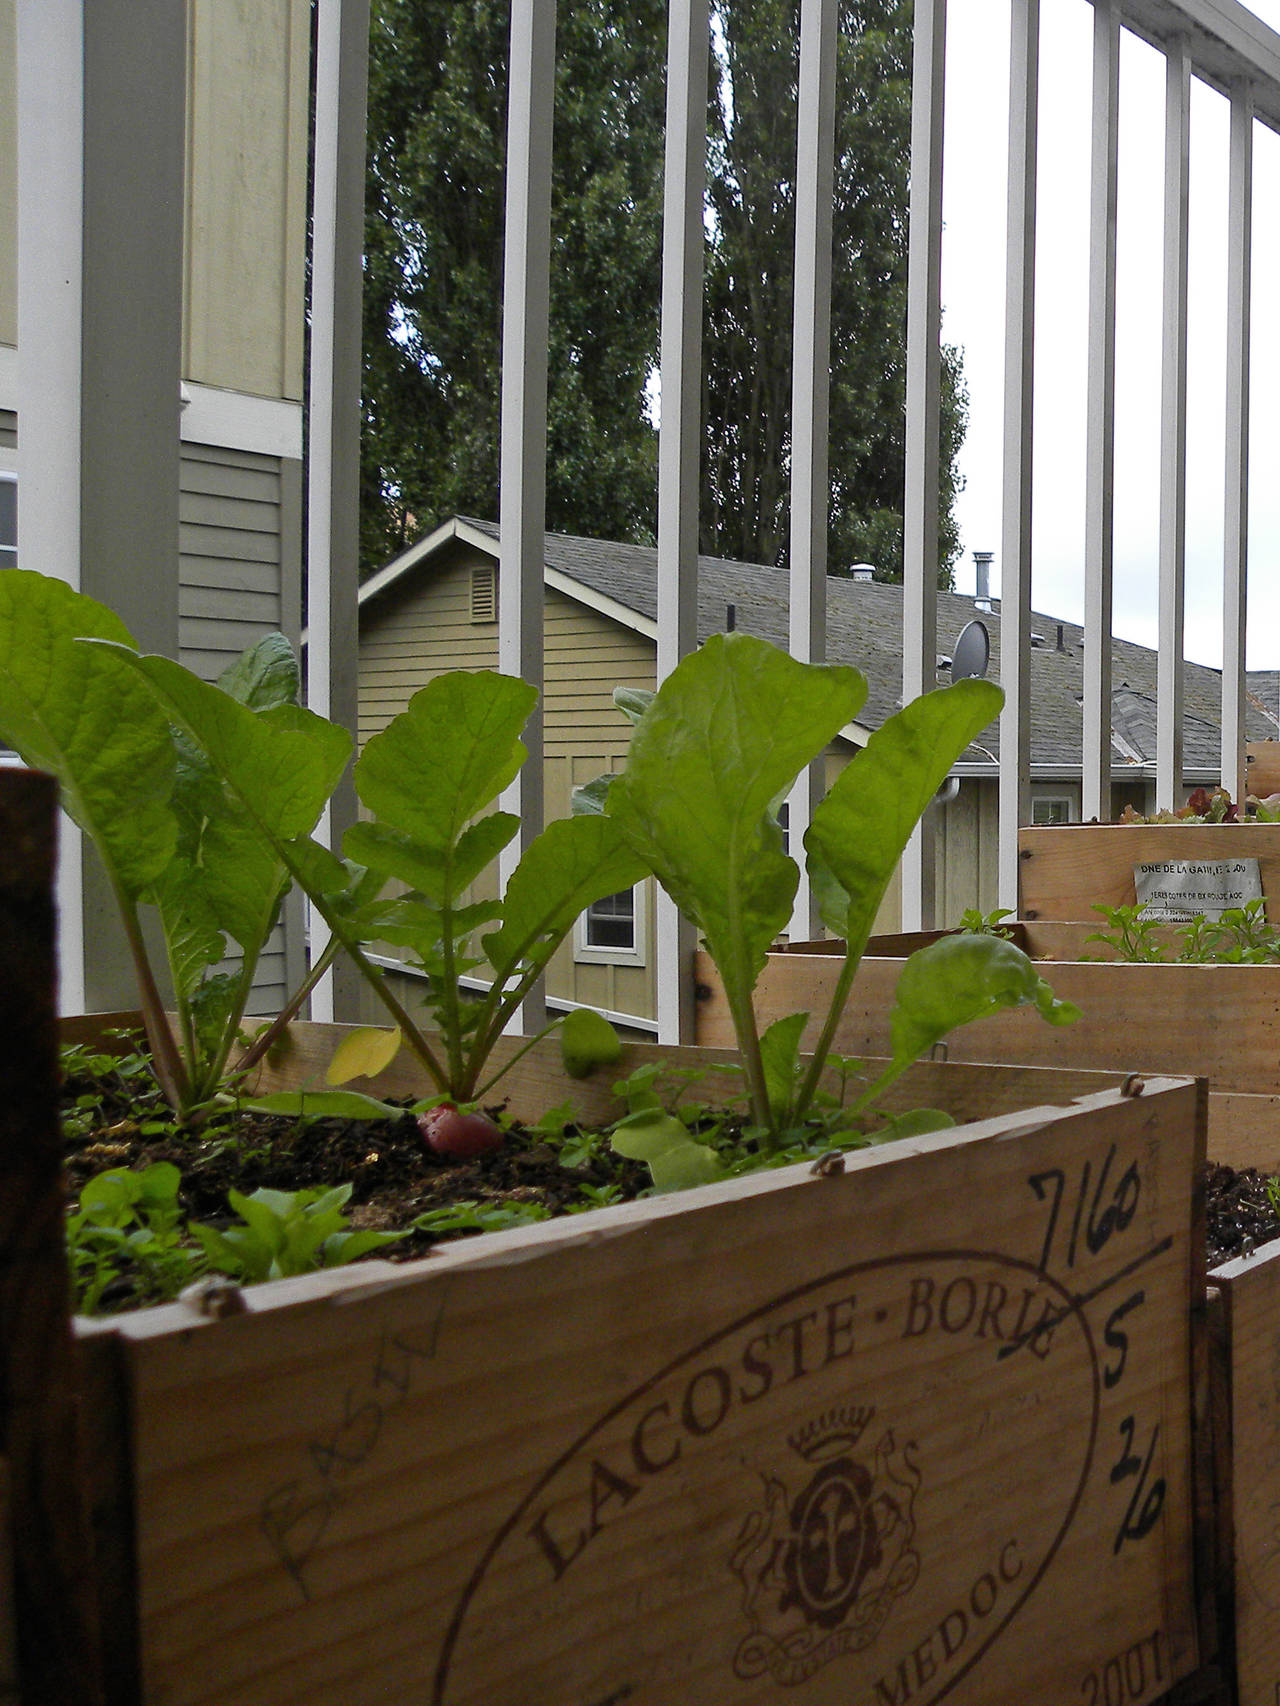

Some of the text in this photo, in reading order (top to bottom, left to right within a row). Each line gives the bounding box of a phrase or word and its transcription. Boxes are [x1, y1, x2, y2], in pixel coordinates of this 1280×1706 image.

[1163, 864, 1175, 874] DE
[522, 1295, 860, 1582] LACOSTE
[872, 1540, 1025, 1706] MEDOC
